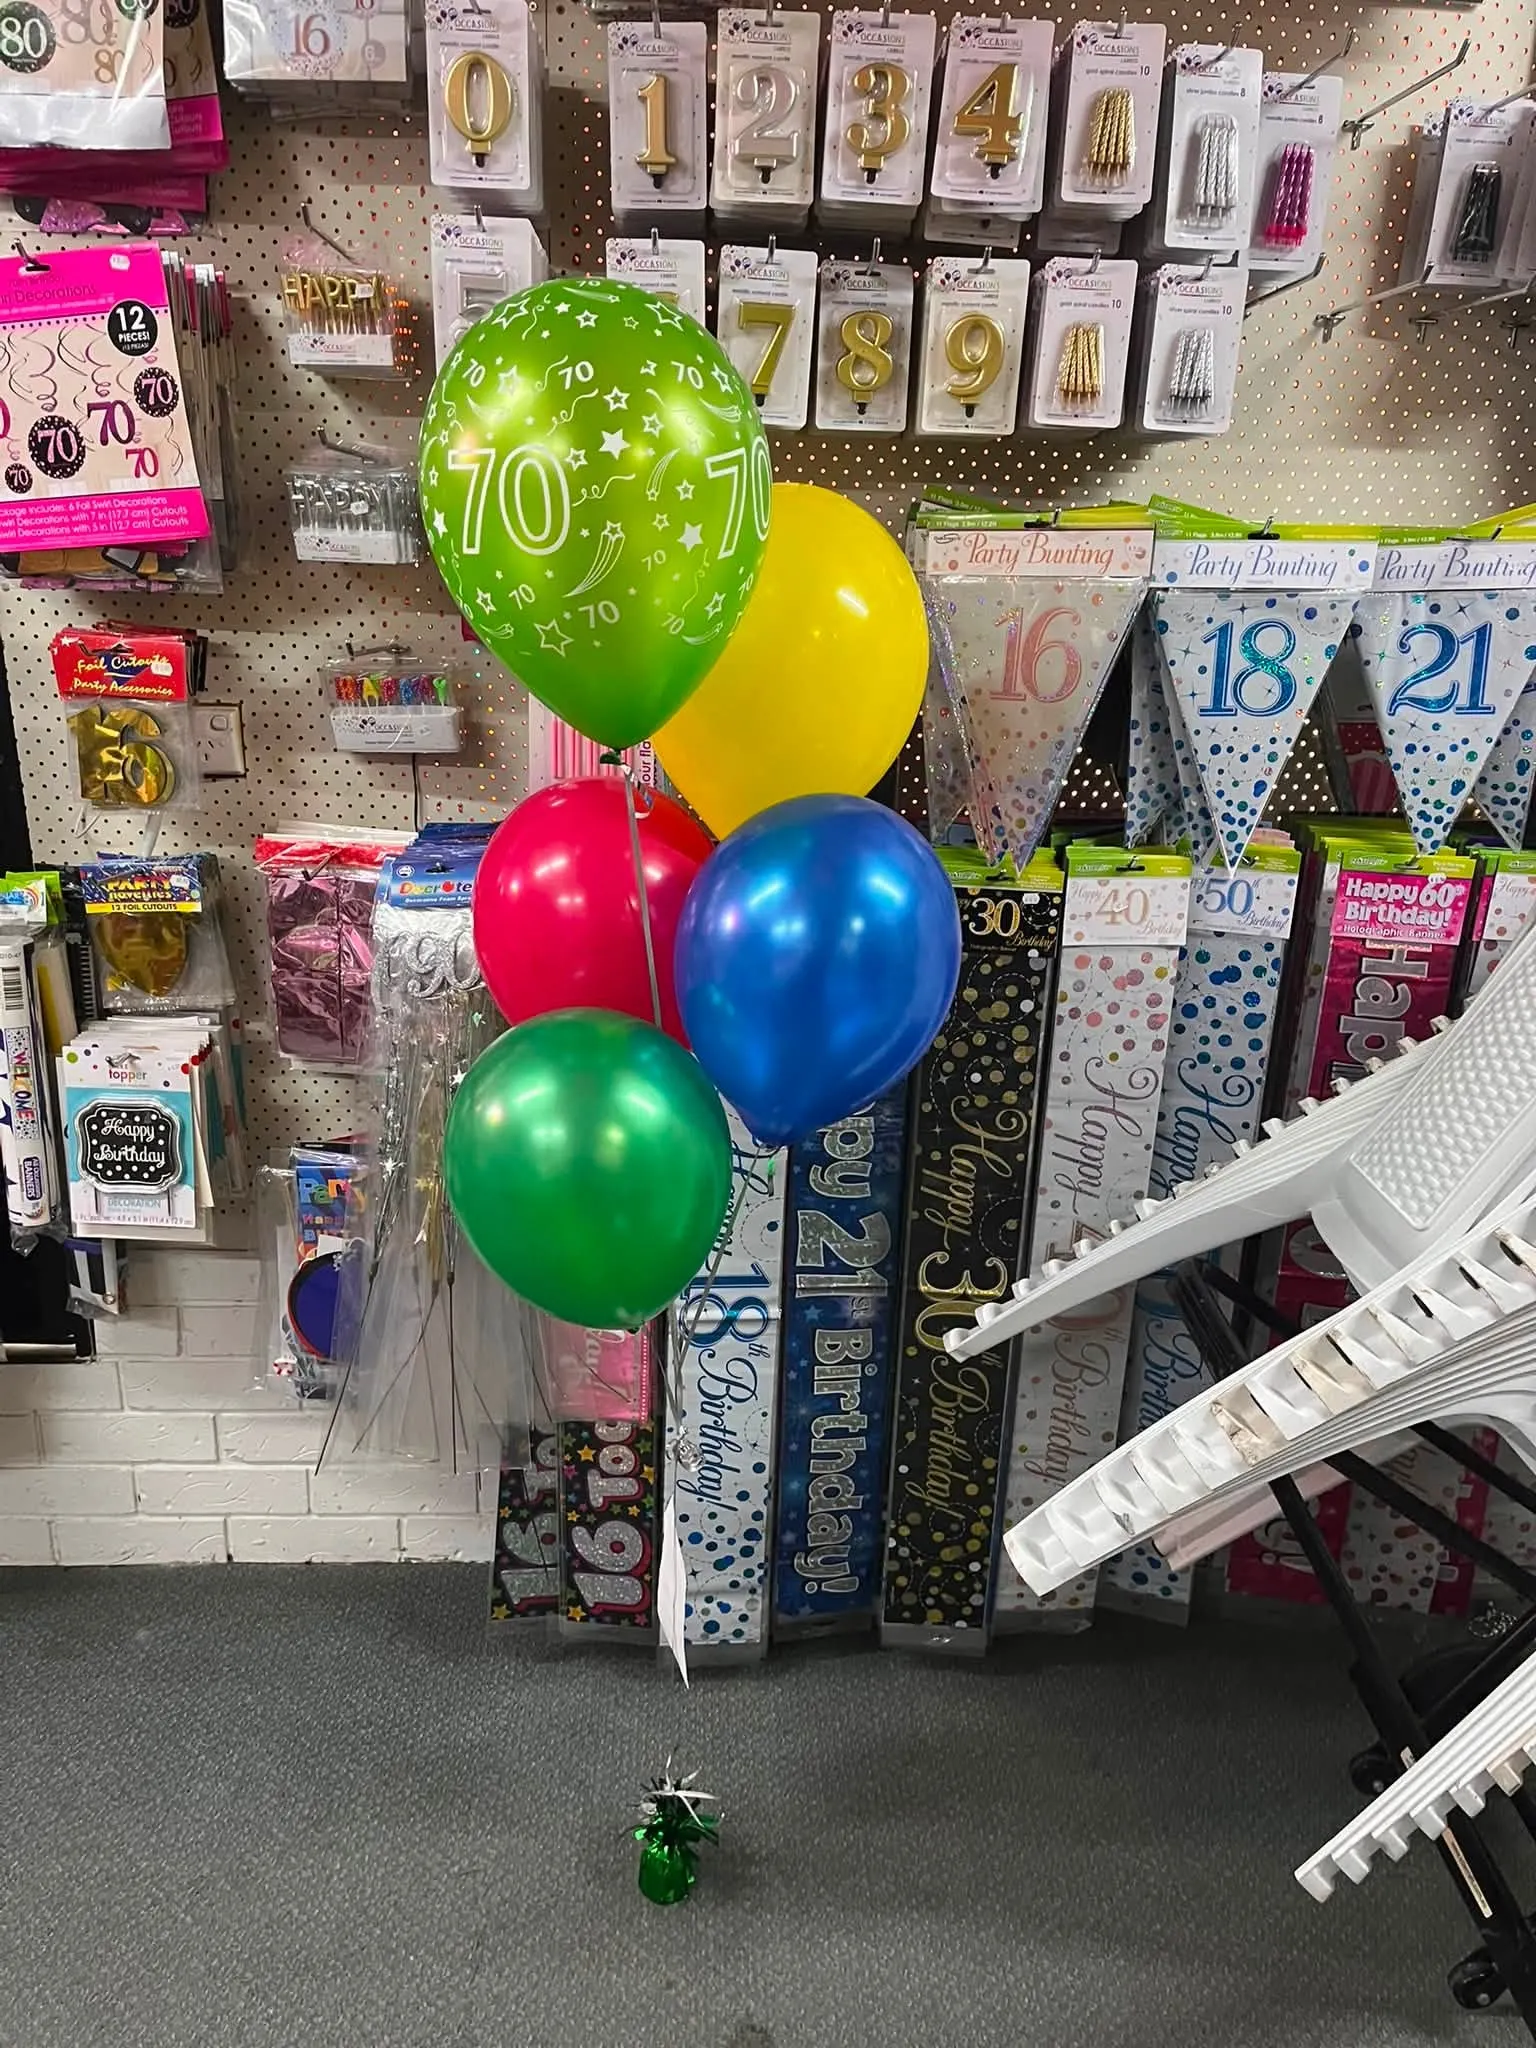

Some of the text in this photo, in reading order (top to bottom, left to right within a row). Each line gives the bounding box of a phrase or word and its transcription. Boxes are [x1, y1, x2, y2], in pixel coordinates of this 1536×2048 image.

[0, 17, 47, 58] 80
[291, 13, 330, 57] 16
[1140, 66, 1150, 76] 10
[1240, 87, 1246, 97] 8
[635, 72, 676, 166] 1
[733, 66, 799, 162] 2
[847, 62, 910, 154] 3
[953, 63, 1024, 160] 4
[1318, 115, 1324, 125] 8
[1507, 137, 1512, 147] 8
[116, 305, 146, 331] 12
[1112, 299, 1122, 309] 10
[1222, 305, 1232, 315] 10
[118, 331, 151, 343] PIECES!
[738, 300, 798, 393] 7
[836, 310, 893, 391] 8
[945, 311, 1005, 397] 9
[462, 359, 486, 387] 70
[559, 361, 594, 390] 70
[671, 361, 703, 390] 70
[140, 376, 173, 406] 70
[87, 399, 135, 446] 70
[37, 426, 79, 463] 70
[9, 468, 29, 486] 70
[125, 447, 159, 478] 70
[112, 497, 167, 508] Decorations
[448, 443, 571, 556] 70
[705, 436, 772, 559] 70
[17, 515, 69, 526] Decorations
[71, 512, 89, 521] with
[151, 506, 188, 516] Cutouts
[152, 516, 189, 527] Cutouts
[642, 550, 666, 572] 70
[963, 532, 1114, 573] Party Bunting
[1184, 543, 1338, 585] Party Bunting
[1379, 549, 1435, 587] Party
[509, 584, 536, 609] 70
[579, 600, 620, 629] 70
[662, 612, 685, 635] 70
[77, 656, 107, 674] Foil
[990, 606, 1082, 703] 16
[1199, 618, 1297, 716] 18
[1387, 622, 1496, 717] 21
[73, 677, 174, 696] Party Accessories
[1071, 881, 1104, 903] Happy
[1344, 877, 1419, 905] Happy
[123, 903, 140, 911] FOIL
[142, 903, 177, 911] CUTOUTS
[969, 897, 1020, 937] 30
[1095, 888, 1150, 925] 40
[1344, 900, 1452, 930] Birthday!
[14, 1051, 35, 1121] WELCOME
[108, 1069, 148, 1084] topper
[101, 1118, 155, 1142] Happy
[1052, 1057, 1159, 1215] Happy
[93, 1144, 165, 1168] Birthday
[24, 1161, 35, 1199] BANNERS
[919, 1095, 1028, 1250] Happy
[107, 1198, 161, 1208] DECORATION
[676, 1348, 758, 1511] Birthday!
[904, 1355, 991, 1519] Birthday!
[794, 1329, 877, 1594] Birthday!
[571, 1520, 646, 1610] 16
